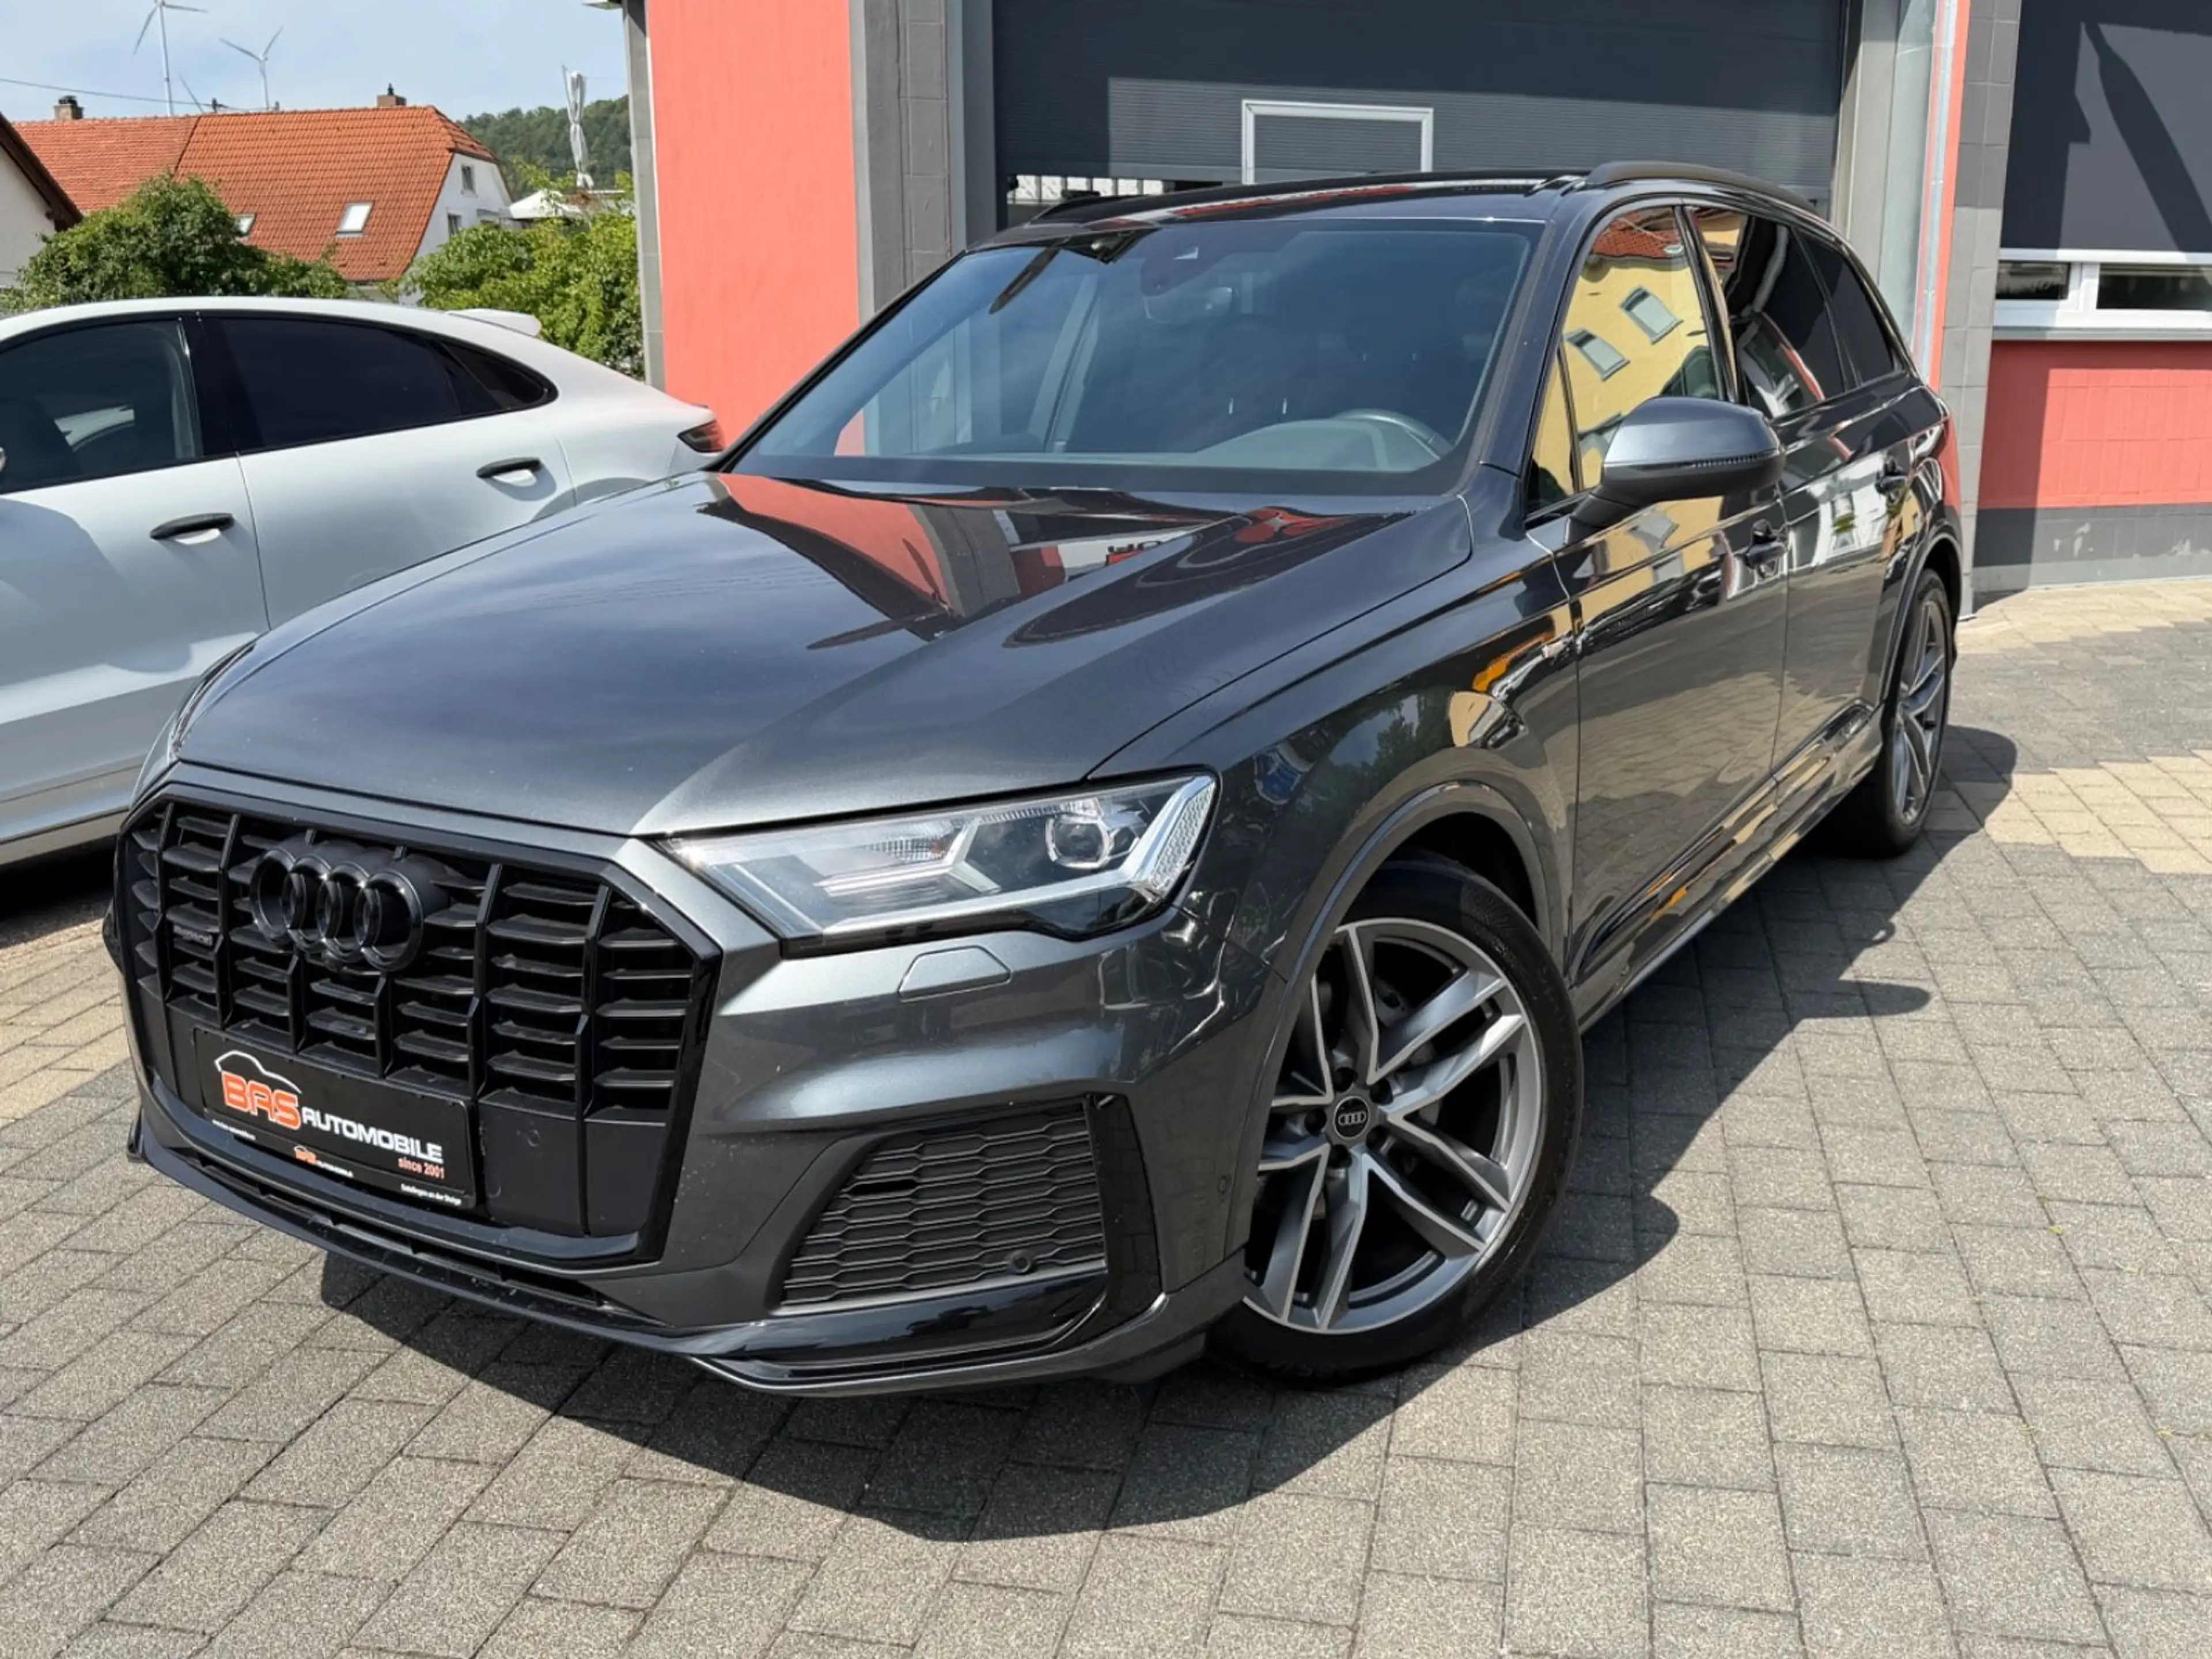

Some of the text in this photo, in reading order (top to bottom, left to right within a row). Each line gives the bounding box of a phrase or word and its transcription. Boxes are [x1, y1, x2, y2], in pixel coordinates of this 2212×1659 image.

[221, 1070, 302, 1131] BAS
[301, 1106, 444, 1165] AUTOMOBILE
[397, 1156, 445, 1180] since 2001
